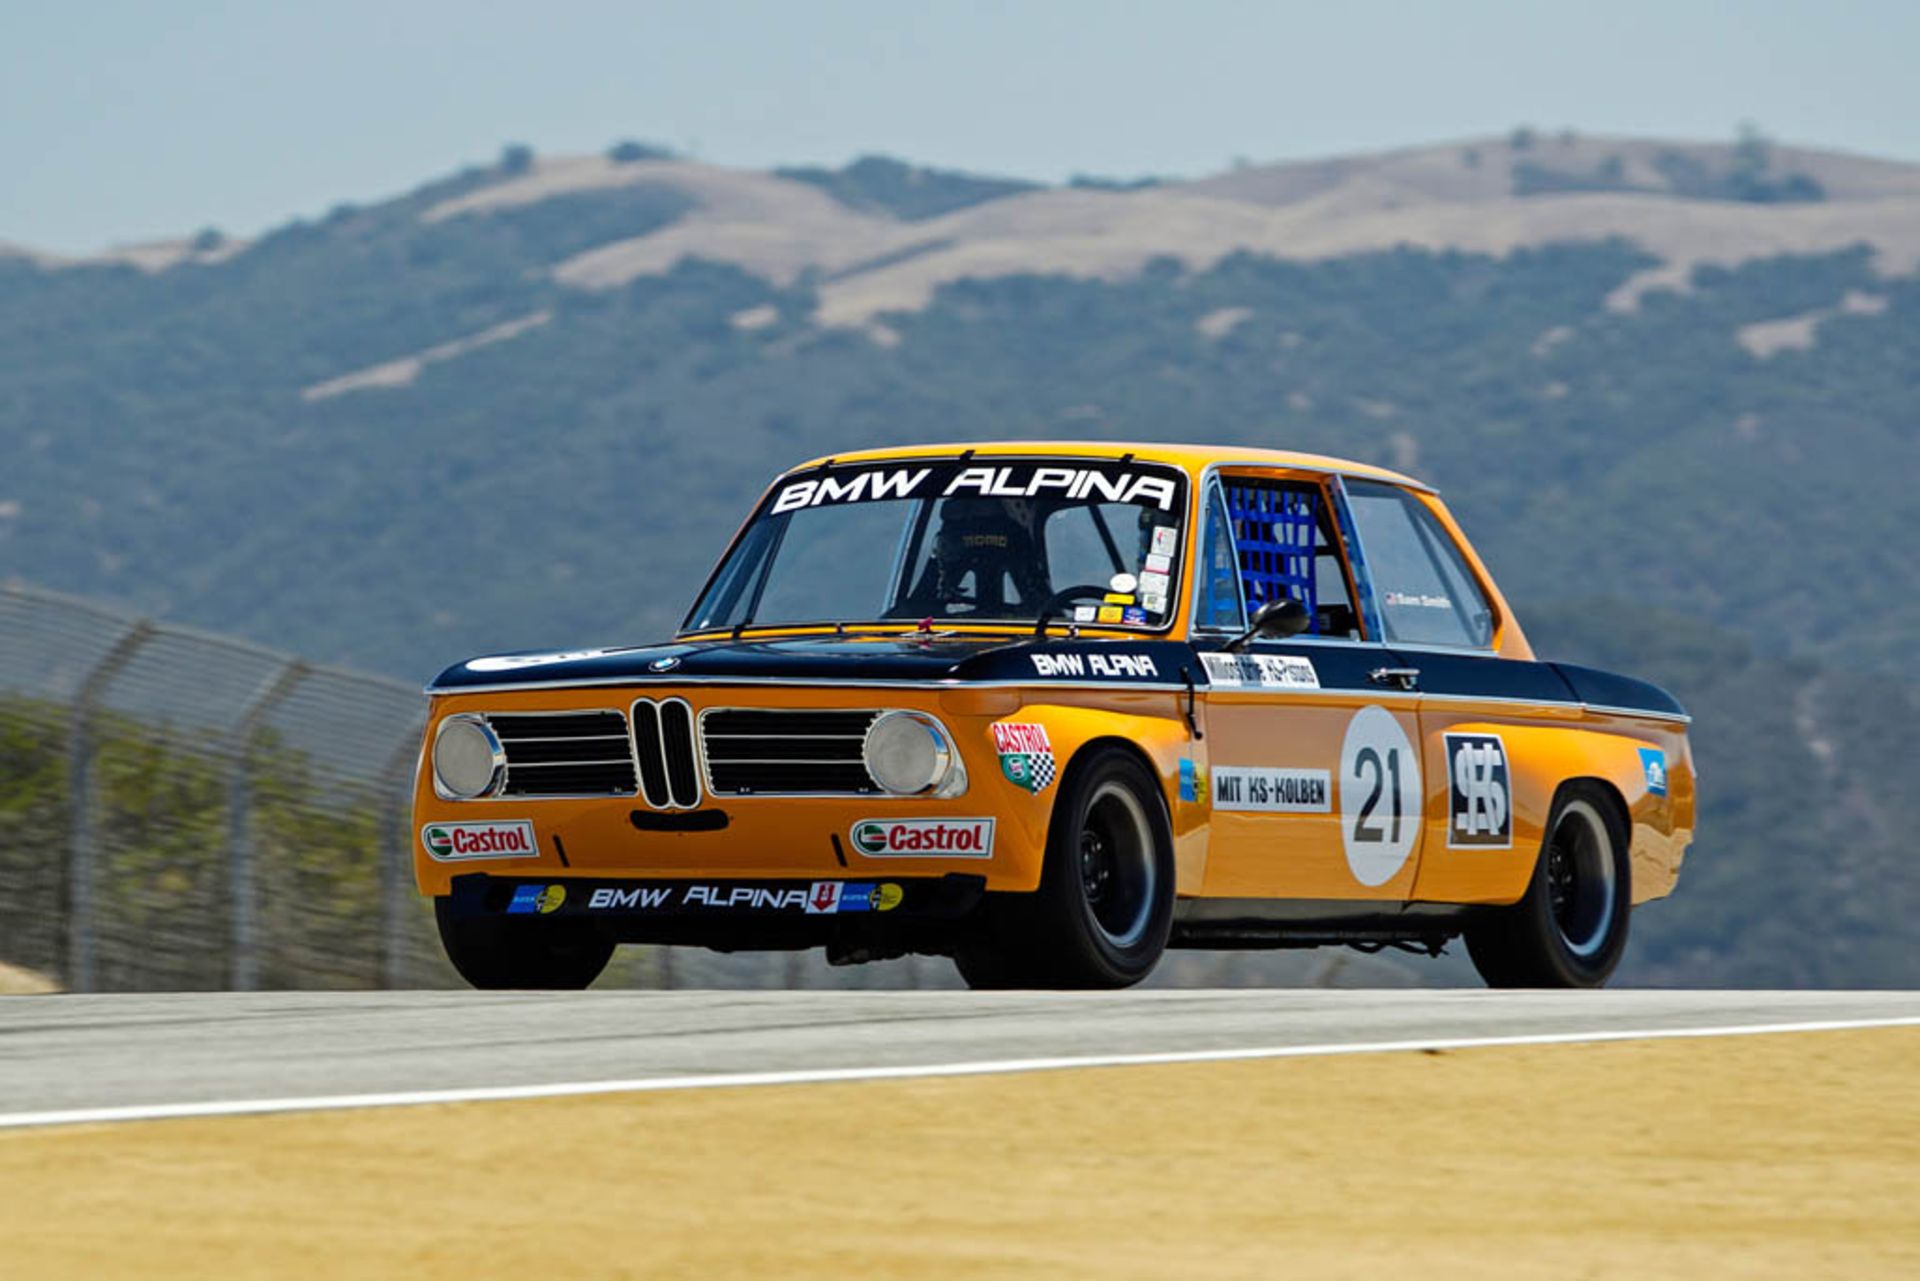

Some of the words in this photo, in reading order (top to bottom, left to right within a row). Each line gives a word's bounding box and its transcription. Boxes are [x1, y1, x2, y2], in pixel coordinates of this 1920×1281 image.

[771, 468, 933, 514] BMW
[943, 467, 1176, 511] ALPINA
[1030, 654, 1085, 676] BMW
[1087, 654, 1159, 677] ALPINA
[993, 724, 1051, 753] CASTROL
[1217, 777, 1241, 803] MIT
[1248, 774, 1325, 805] KS-KOLBEN
[1353, 747, 1402, 843] 21
[452, 826, 530, 853] Castrol
[888, 824, 982, 851] Castrol
[588, 888, 671, 908] BMW
[682, 886, 809, 909] ALPINA
